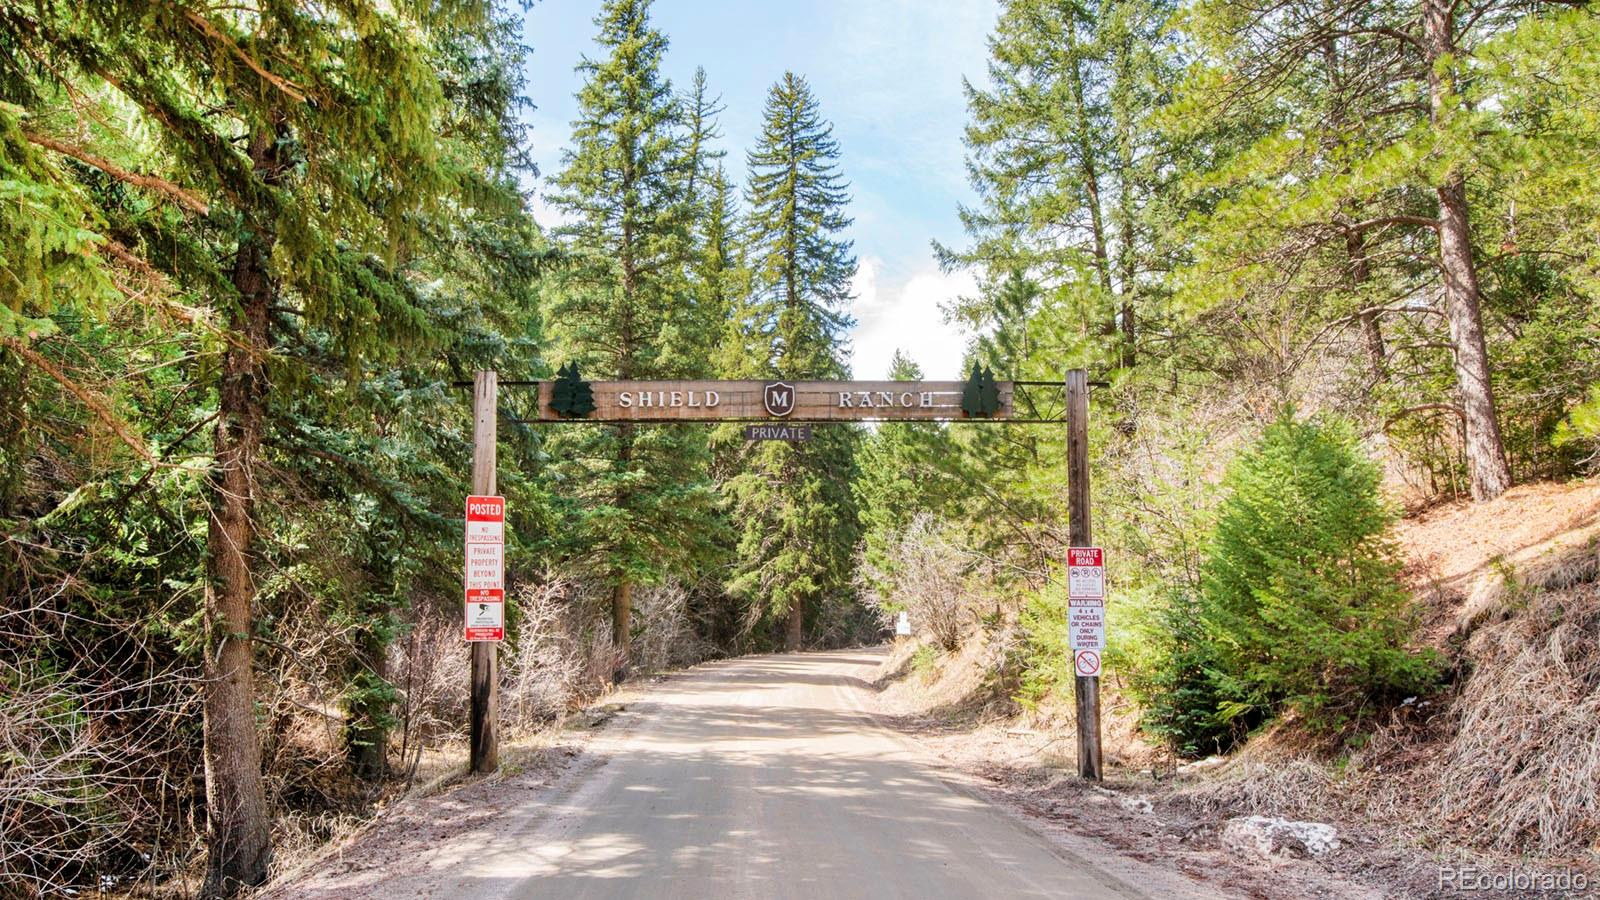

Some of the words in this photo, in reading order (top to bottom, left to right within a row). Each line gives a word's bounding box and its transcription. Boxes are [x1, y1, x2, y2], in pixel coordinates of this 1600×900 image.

[619, 391, 720, 408] SHIELD
[771, 391, 787, 407] M
[839, 392, 934, 408] RANCH
[752, 427, 805, 440] PRIVATE
[469, 503, 501, 515] POSTED
[473, 547, 496, 555] PRIVATE
[1071, 550, 1099, 558] PRIVATE
[470, 559, 498, 567] PROPERTY
[1076, 558, 1095, 566] ROAD
[473, 570, 496, 578] BEYOND
